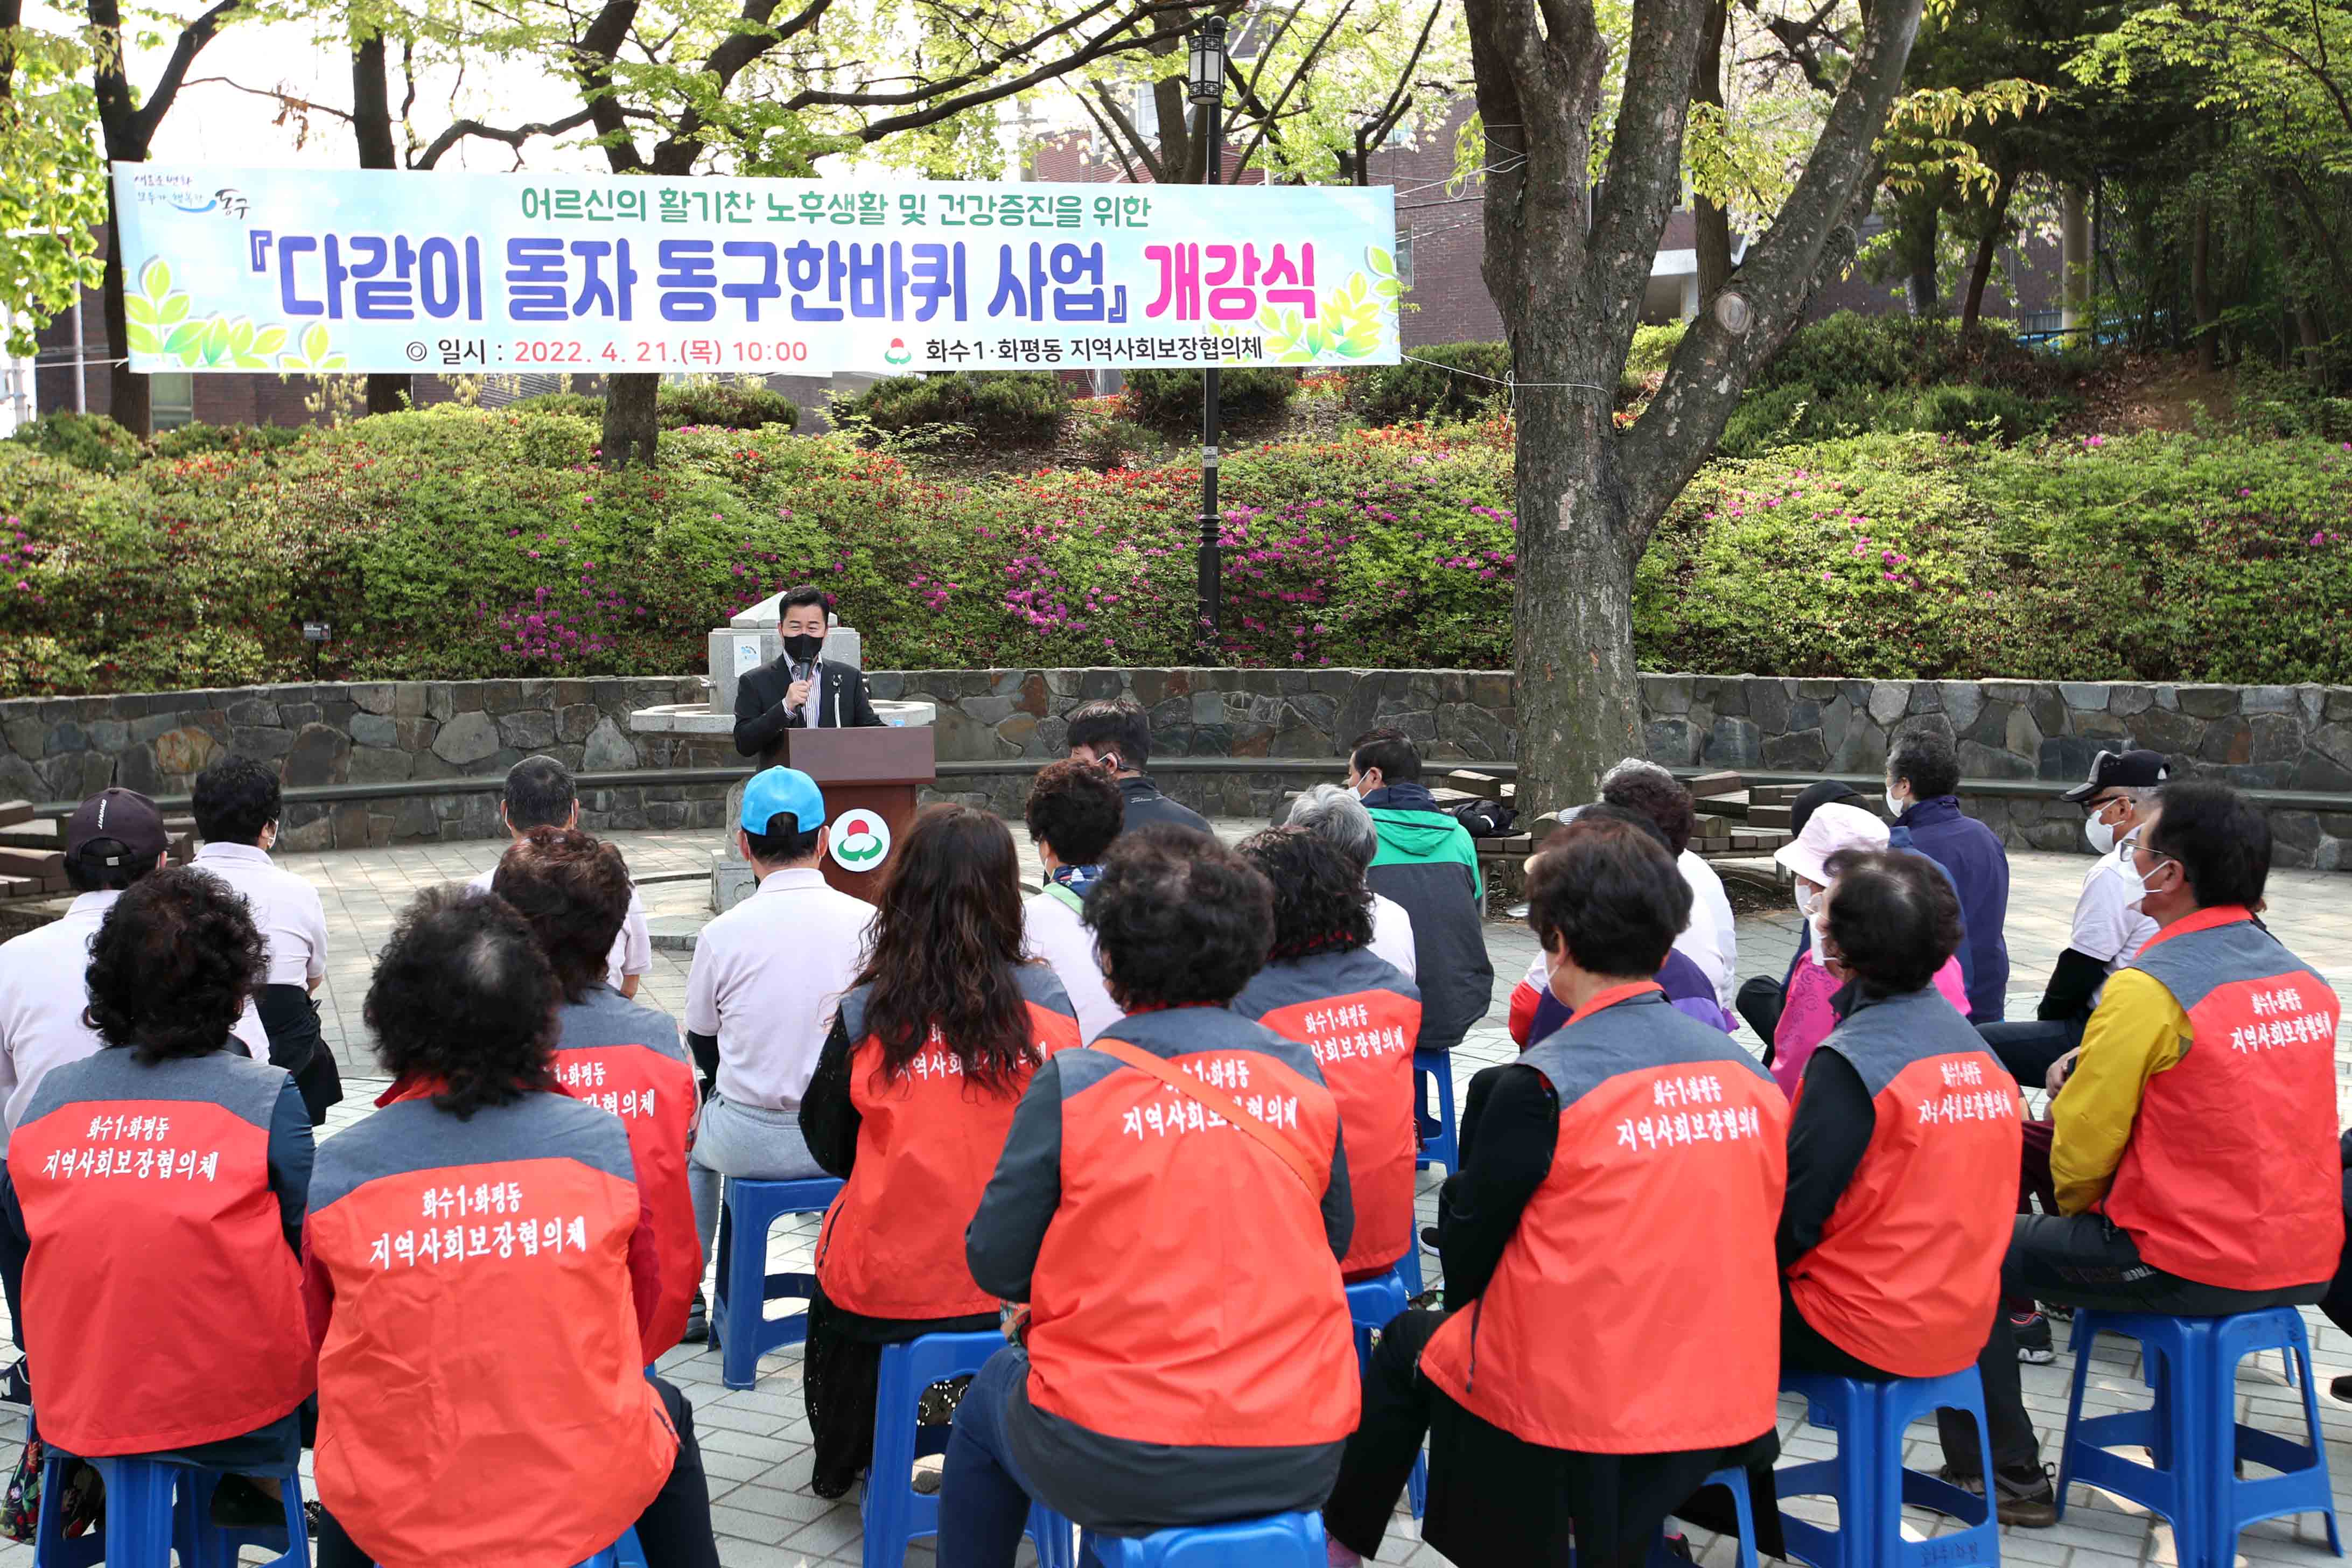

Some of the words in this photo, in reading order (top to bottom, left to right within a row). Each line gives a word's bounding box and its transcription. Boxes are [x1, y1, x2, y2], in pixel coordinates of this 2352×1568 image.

[522, 188, 645, 221] 어르신의
[660, 190, 753, 223] 활기찬
[767, 192, 887, 225] 노후생활
[899, 195, 925, 225] 및
[939, 195, 1081, 227] 건강증진을
[1094, 197, 1150, 227] 위한
[250, 230, 482, 319] 『다같이
[506, 238, 638, 321] 돌자
[657, 239, 967, 322] 동구한바퀴
[988, 242, 1127, 323] 사업』
[1145, 243, 1317, 320] 개강식
[515, 341, 592, 362] 2022.
[601, 341, 626, 362] 4.
[636, 340, 722, 365] 21.(목)
[733, 341, 807, 362] 10:00
[1070, 336, 1262, 361] 지역사회보장협의체
[1310, 1024, 1405, 1066] 사회보장협의체
[1616, 1105, 1759, 1152] 지역사회보장협의체
[42, 1147, 219, 1182] 지역사회보장협의체
[369, 1214, 586, 1270] 지역사회보장협의체
